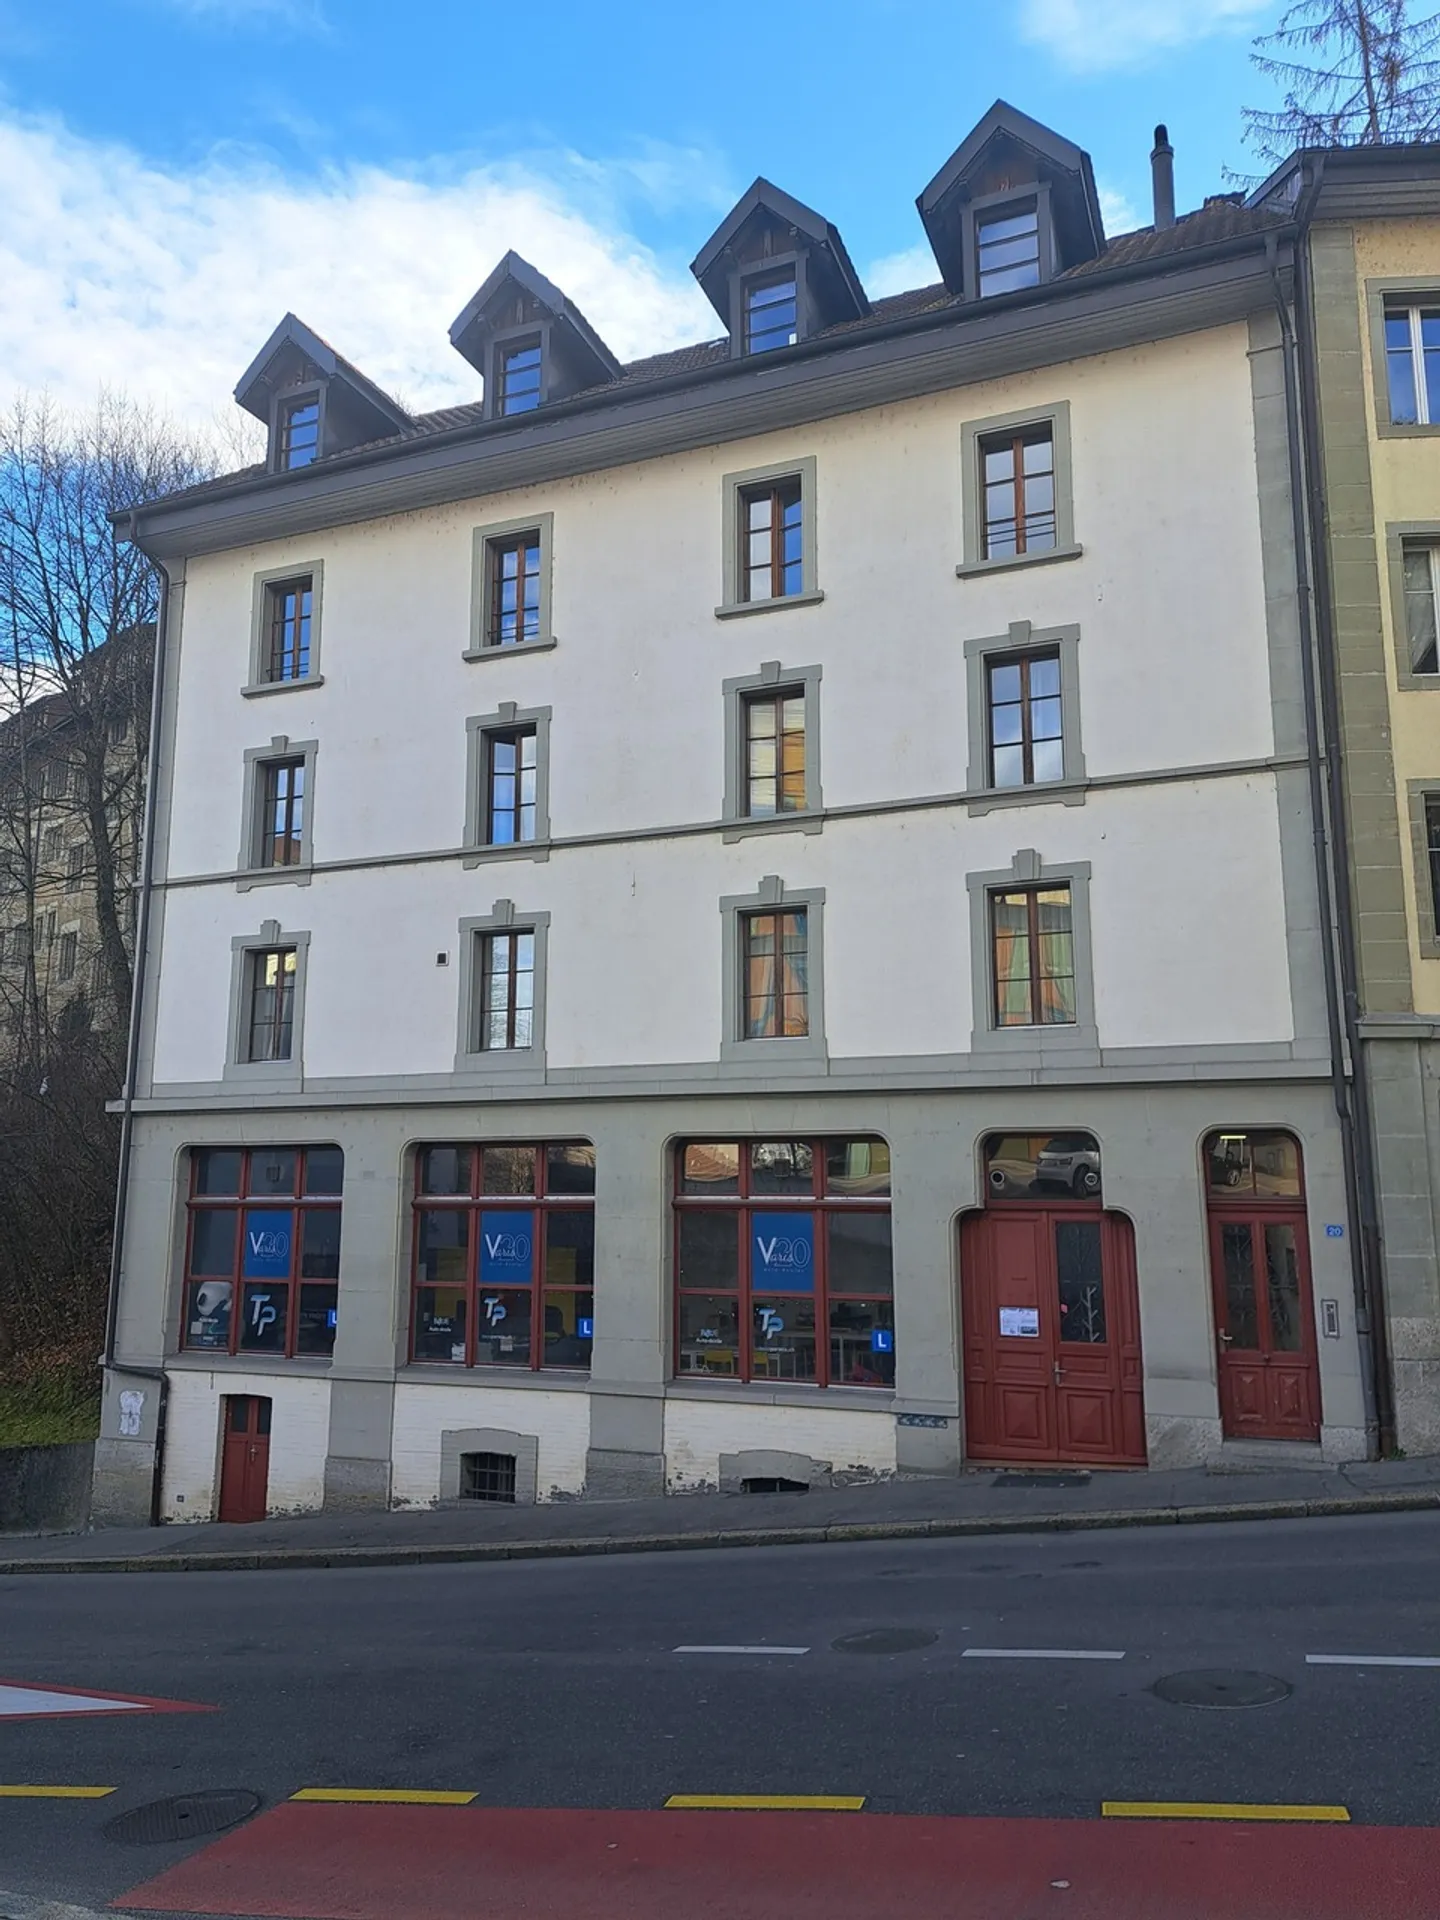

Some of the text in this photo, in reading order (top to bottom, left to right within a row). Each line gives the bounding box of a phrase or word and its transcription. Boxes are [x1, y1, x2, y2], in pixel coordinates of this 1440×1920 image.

[1328, 1227, 1341, 1237] 20
[250, 1294, 277, 1337] TP
[484, 1297, 506, 1327] TP
[583, 1320, 591, 1334] L
[759, 1308, 784, 1340] TP
[877, 1332, 887, 1348] L
